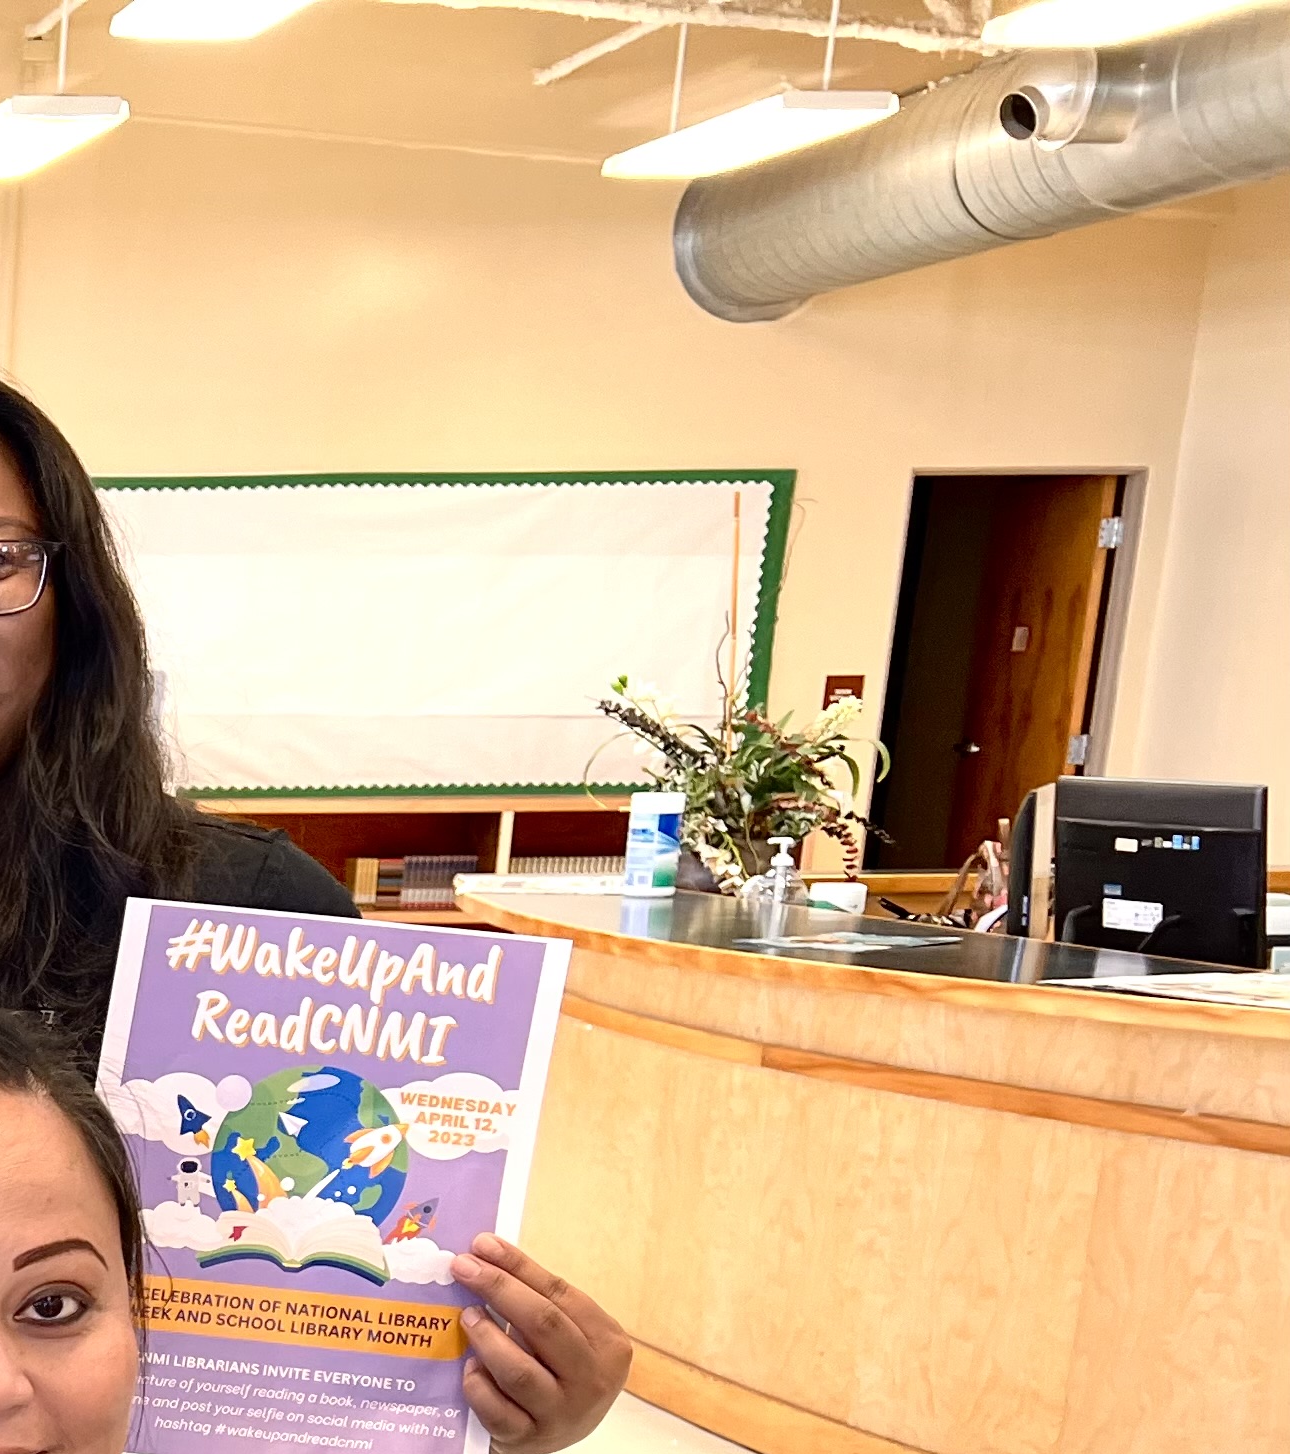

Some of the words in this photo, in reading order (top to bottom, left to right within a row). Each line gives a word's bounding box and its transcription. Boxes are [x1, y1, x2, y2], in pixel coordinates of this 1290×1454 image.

[164, 918, 503, 1004] #WakeUpAnd
[191, 990, 458, 1067] ReadCNMI
[400, 1092, 517, 1117] WEDNESDAY
[414, 1111, 469, 1128] APRIL
[474, 1117, 497, 1133] 12,
[427, 1131, 475, 1148] 2023
[133, 1305, 172, 1321] EEK
[174, 1308, 211, 1324] AND
[215, 1313, 285, 1332] SCHOOL
[290, 1320, 363, 1340] LIBRARY
[366, 1329, 432, 1347] MONTH
[258, 1299, 281, 1313] OF
[285, 1302, 372, 1323] NATIONAL
[378, 1311, 452, 1331] LIBRARY
[138, 1352, 171, 1367] NMI
[173, 1354, 259, 1375] LIBRARIANS
[262, 1364, 310, 1380] INVITE
[313, 1370, 392, 1389] EVERYONE
[395, 1378, 415, 1391] TO
[154, 1415, 211, 1435] hashtag
[214, 1423, 373, 1449] #wakeupandreadcnmi
